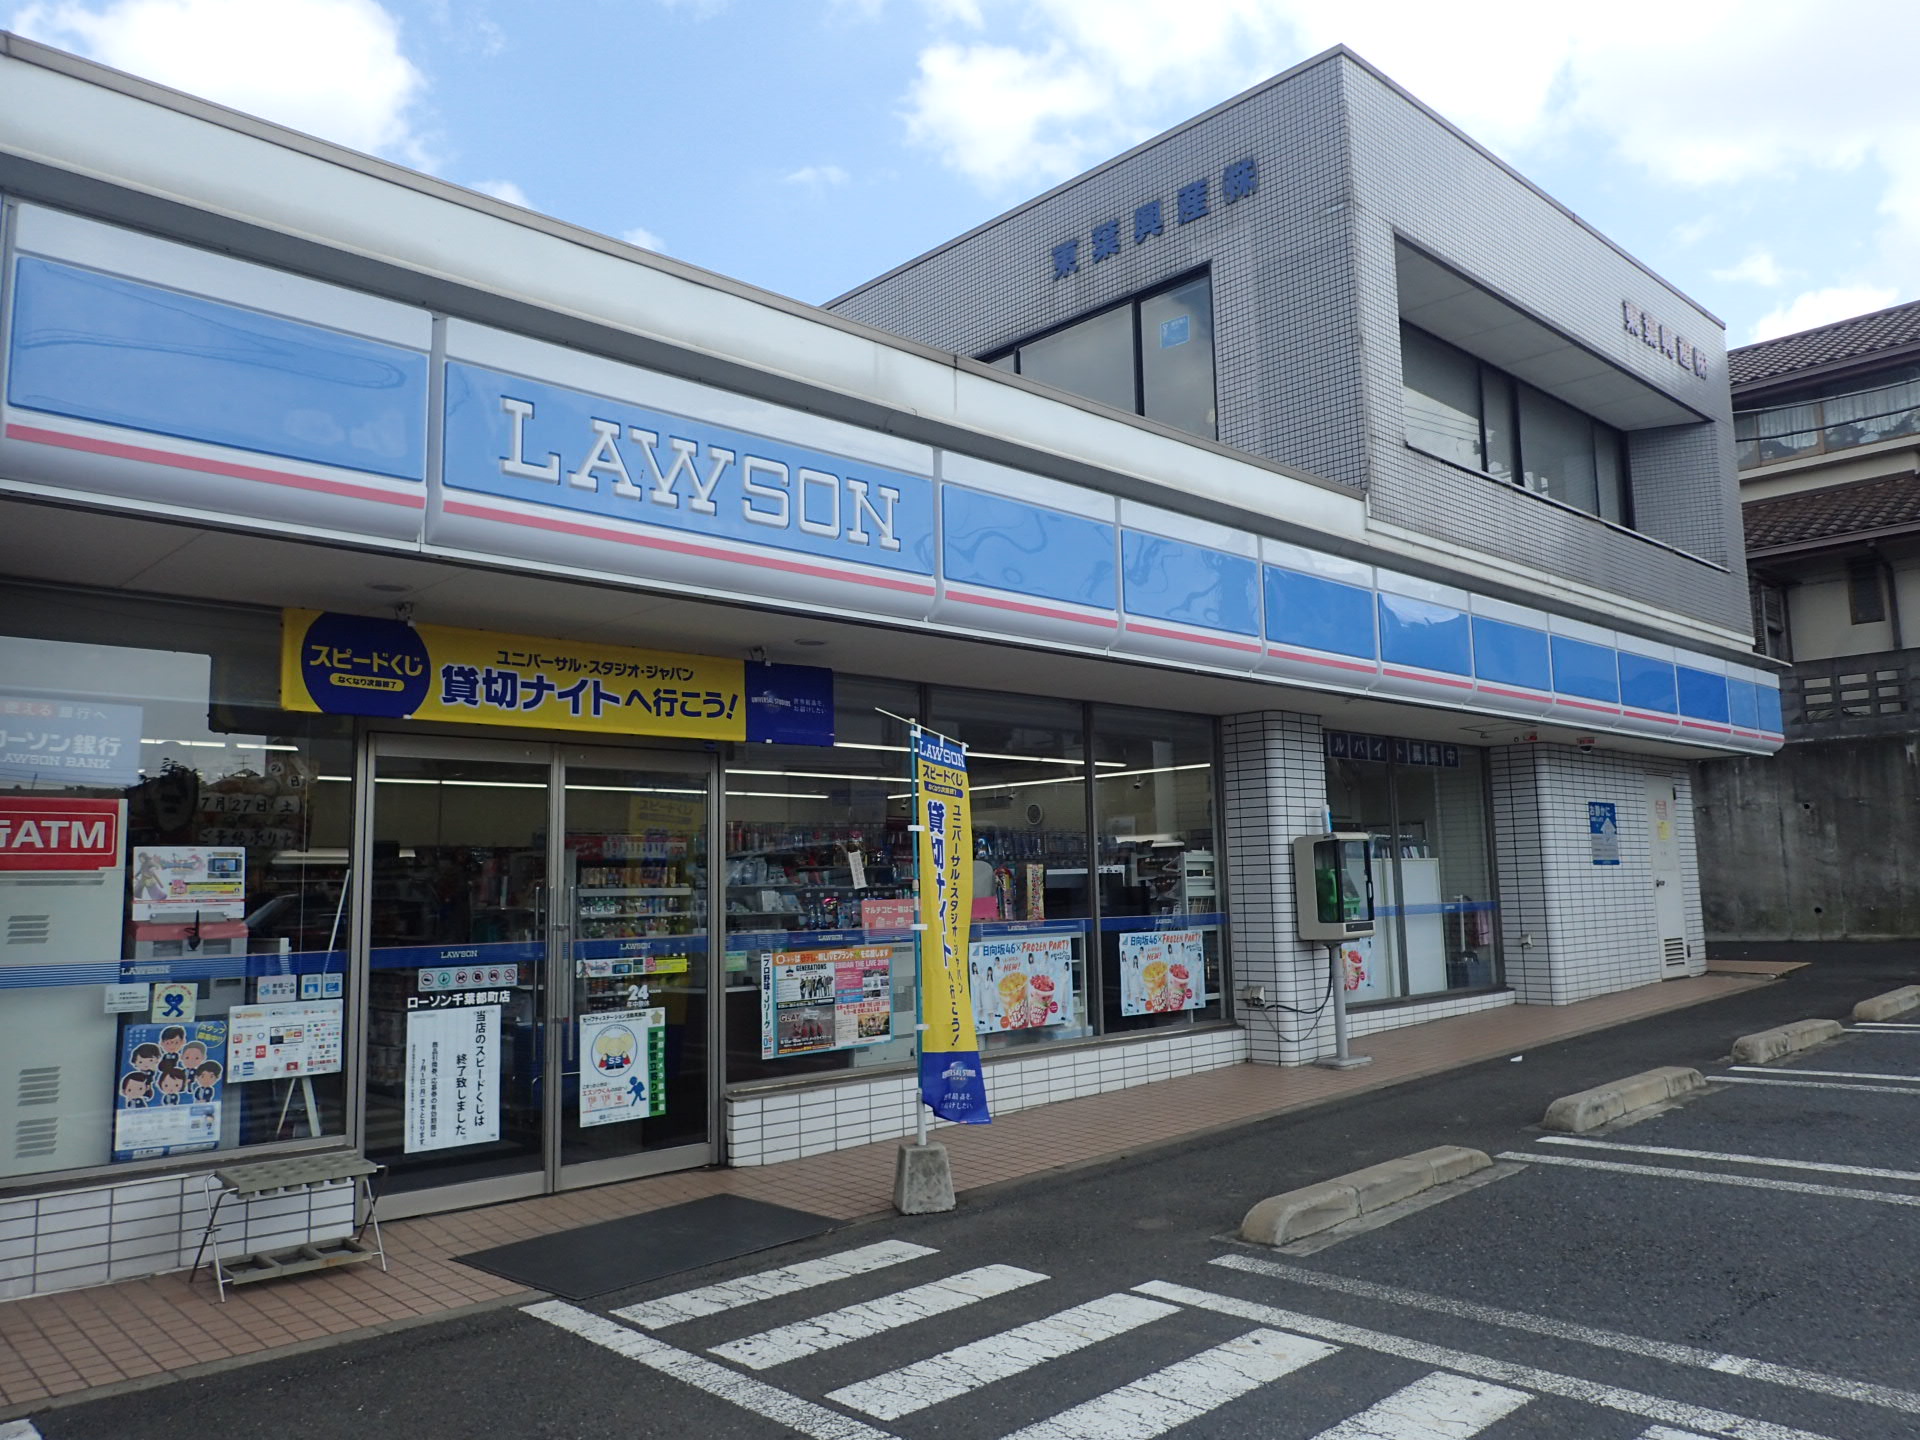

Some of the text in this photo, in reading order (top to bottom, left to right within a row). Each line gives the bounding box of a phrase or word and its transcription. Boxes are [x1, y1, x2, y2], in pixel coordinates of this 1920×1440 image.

[500, 395, 902, 553] LAWSON
[310, 645, 423, 677] スピードくじ
[496, 650, 694, 681] ユニバーサル・スタジオ・ジャパン
[337, 676, 398, 690] なくなり次第終了
[2, 752, 111, 770] AWSON BANK
[919, 741, 966, 768] LAWSON
[922, 764, 963, 787] スピードくじ
[441, 950, 478, 959] LAWSON
[796, 963, 827, 972] GENERATIONS
[407, 990, 511, 1009] ローソン千葉都町店
[628, 984, 650, 1001] 24
[474, 1010, 487, 1127] 当店のスピードくじは
